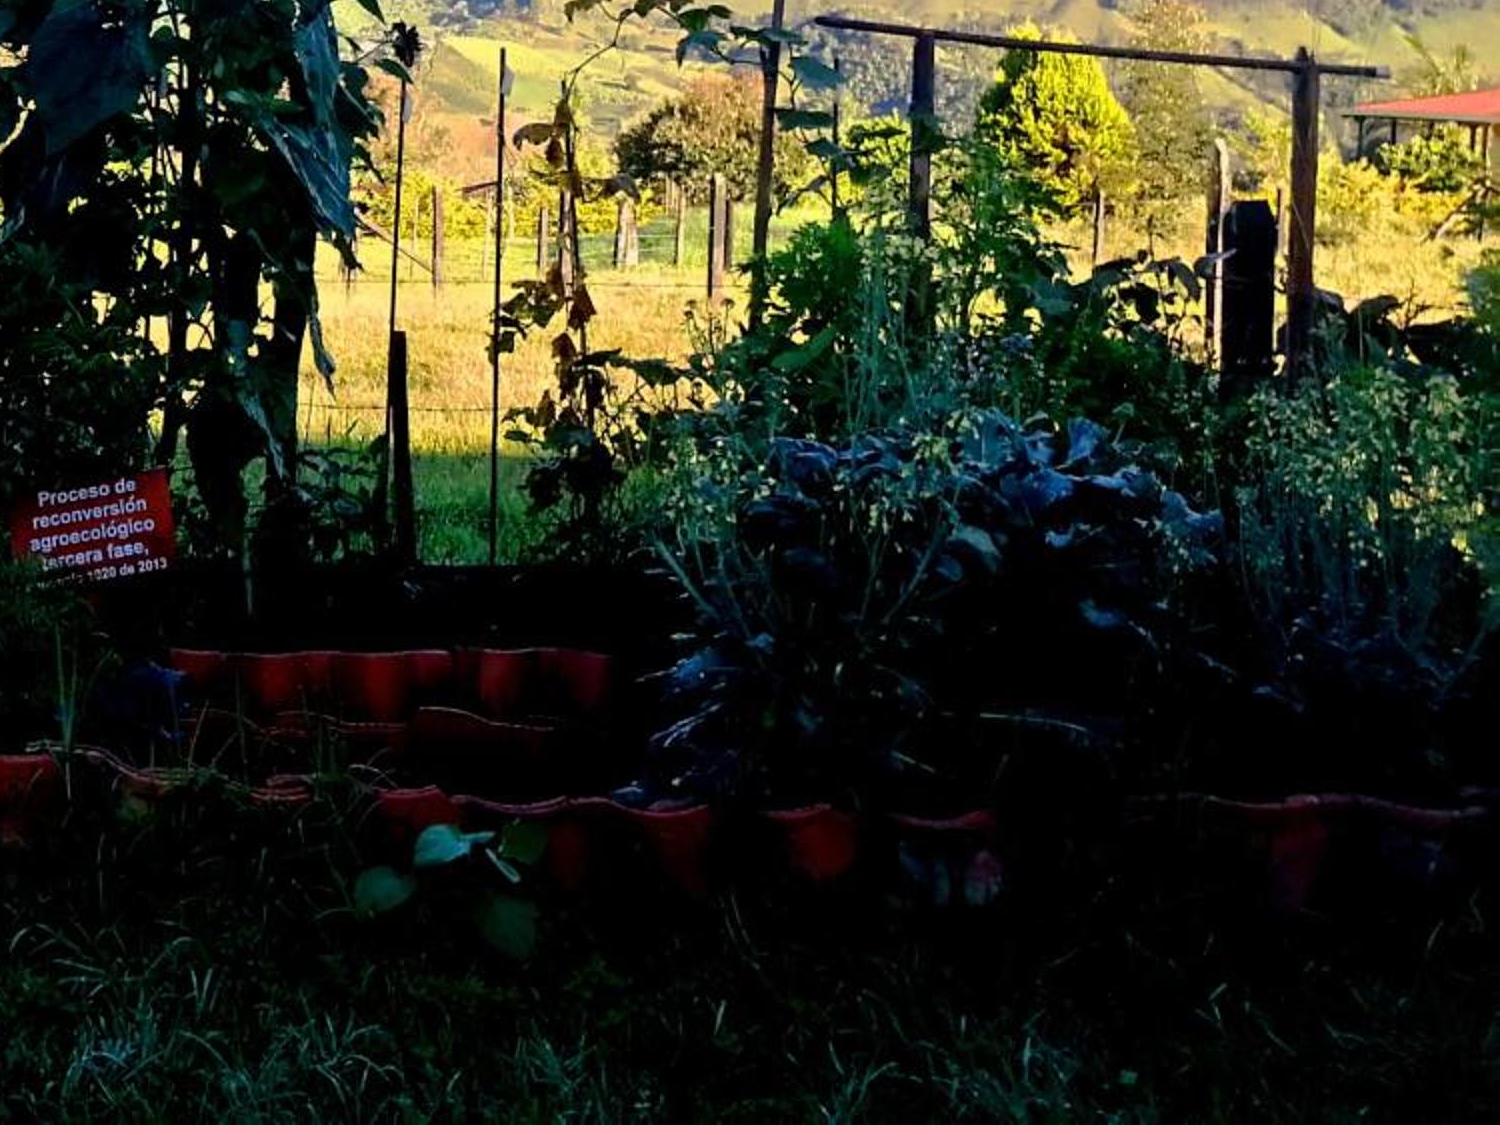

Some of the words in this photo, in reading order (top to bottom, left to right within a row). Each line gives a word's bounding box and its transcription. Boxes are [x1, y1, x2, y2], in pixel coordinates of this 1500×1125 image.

[37, 483, 110, 508] Proceso
[114, 478, 136, 494] de
[32, 495, 147, 530] reconversión
[30, 518, 155, 553] agroecológico
[107, 542, 149, 560] fase,
[119, 563, 135, 576] de
[137, 557, 168, 573] 2013
